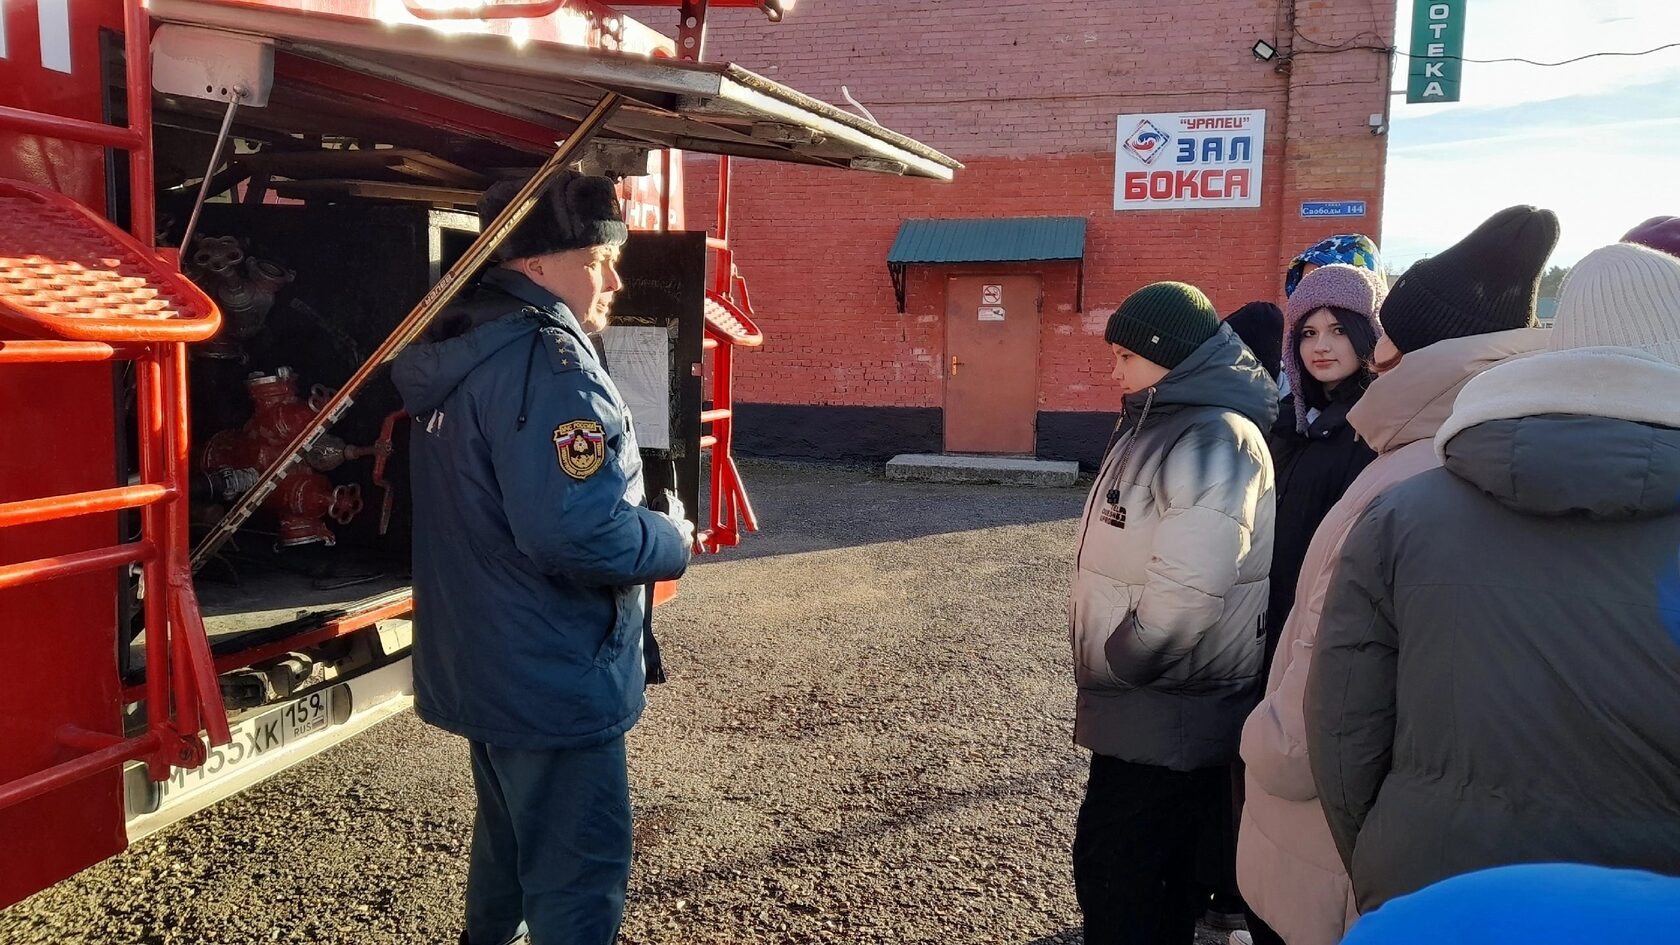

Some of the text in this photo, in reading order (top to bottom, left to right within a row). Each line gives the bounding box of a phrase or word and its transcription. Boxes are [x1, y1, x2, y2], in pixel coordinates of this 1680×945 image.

[1176, 136, 1251, 163] ЗАЛ
[1124, 168, 1250, 200] БОКСА
[1347, 205, 1363, 214] 144
[285, 694, 321, 728] 159
[293, 723, 312, 738] RUS
